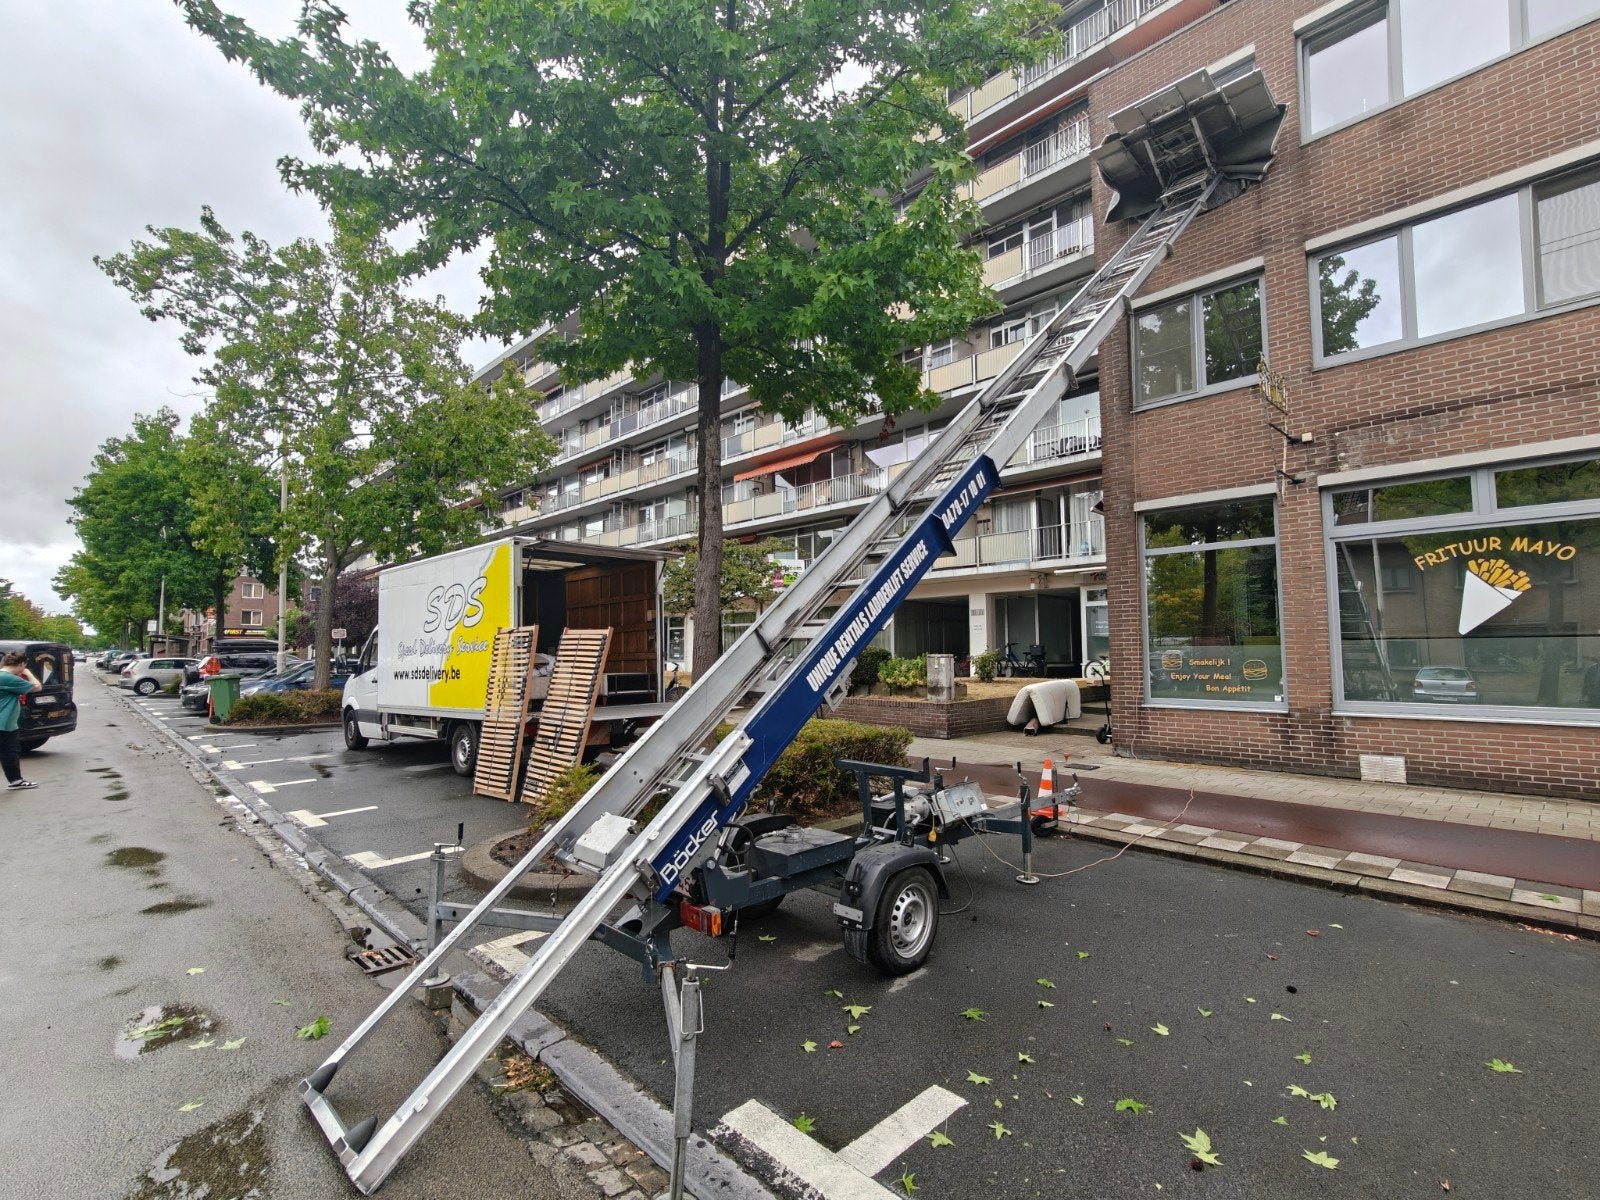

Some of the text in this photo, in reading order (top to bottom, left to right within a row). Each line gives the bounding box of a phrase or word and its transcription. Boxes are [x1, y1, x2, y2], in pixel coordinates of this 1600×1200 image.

[968, 480, 979, 498] 10
[976, 470, 986, 489] 01
[1414, 537, 1576, 571] FRITUUR MAYO
[423, 576, 488, 633] SDS
[806, 539, 929, 692] UNIQUE RENTALS LADDERLIFT SERVICE
[456, 636, 488, 656] Service
[393, 665, 461, 682] www.sdsdelivery.be
[1170, 673, 1191, 681] Enjoy
[659, 809, 718, 885] Böcker
